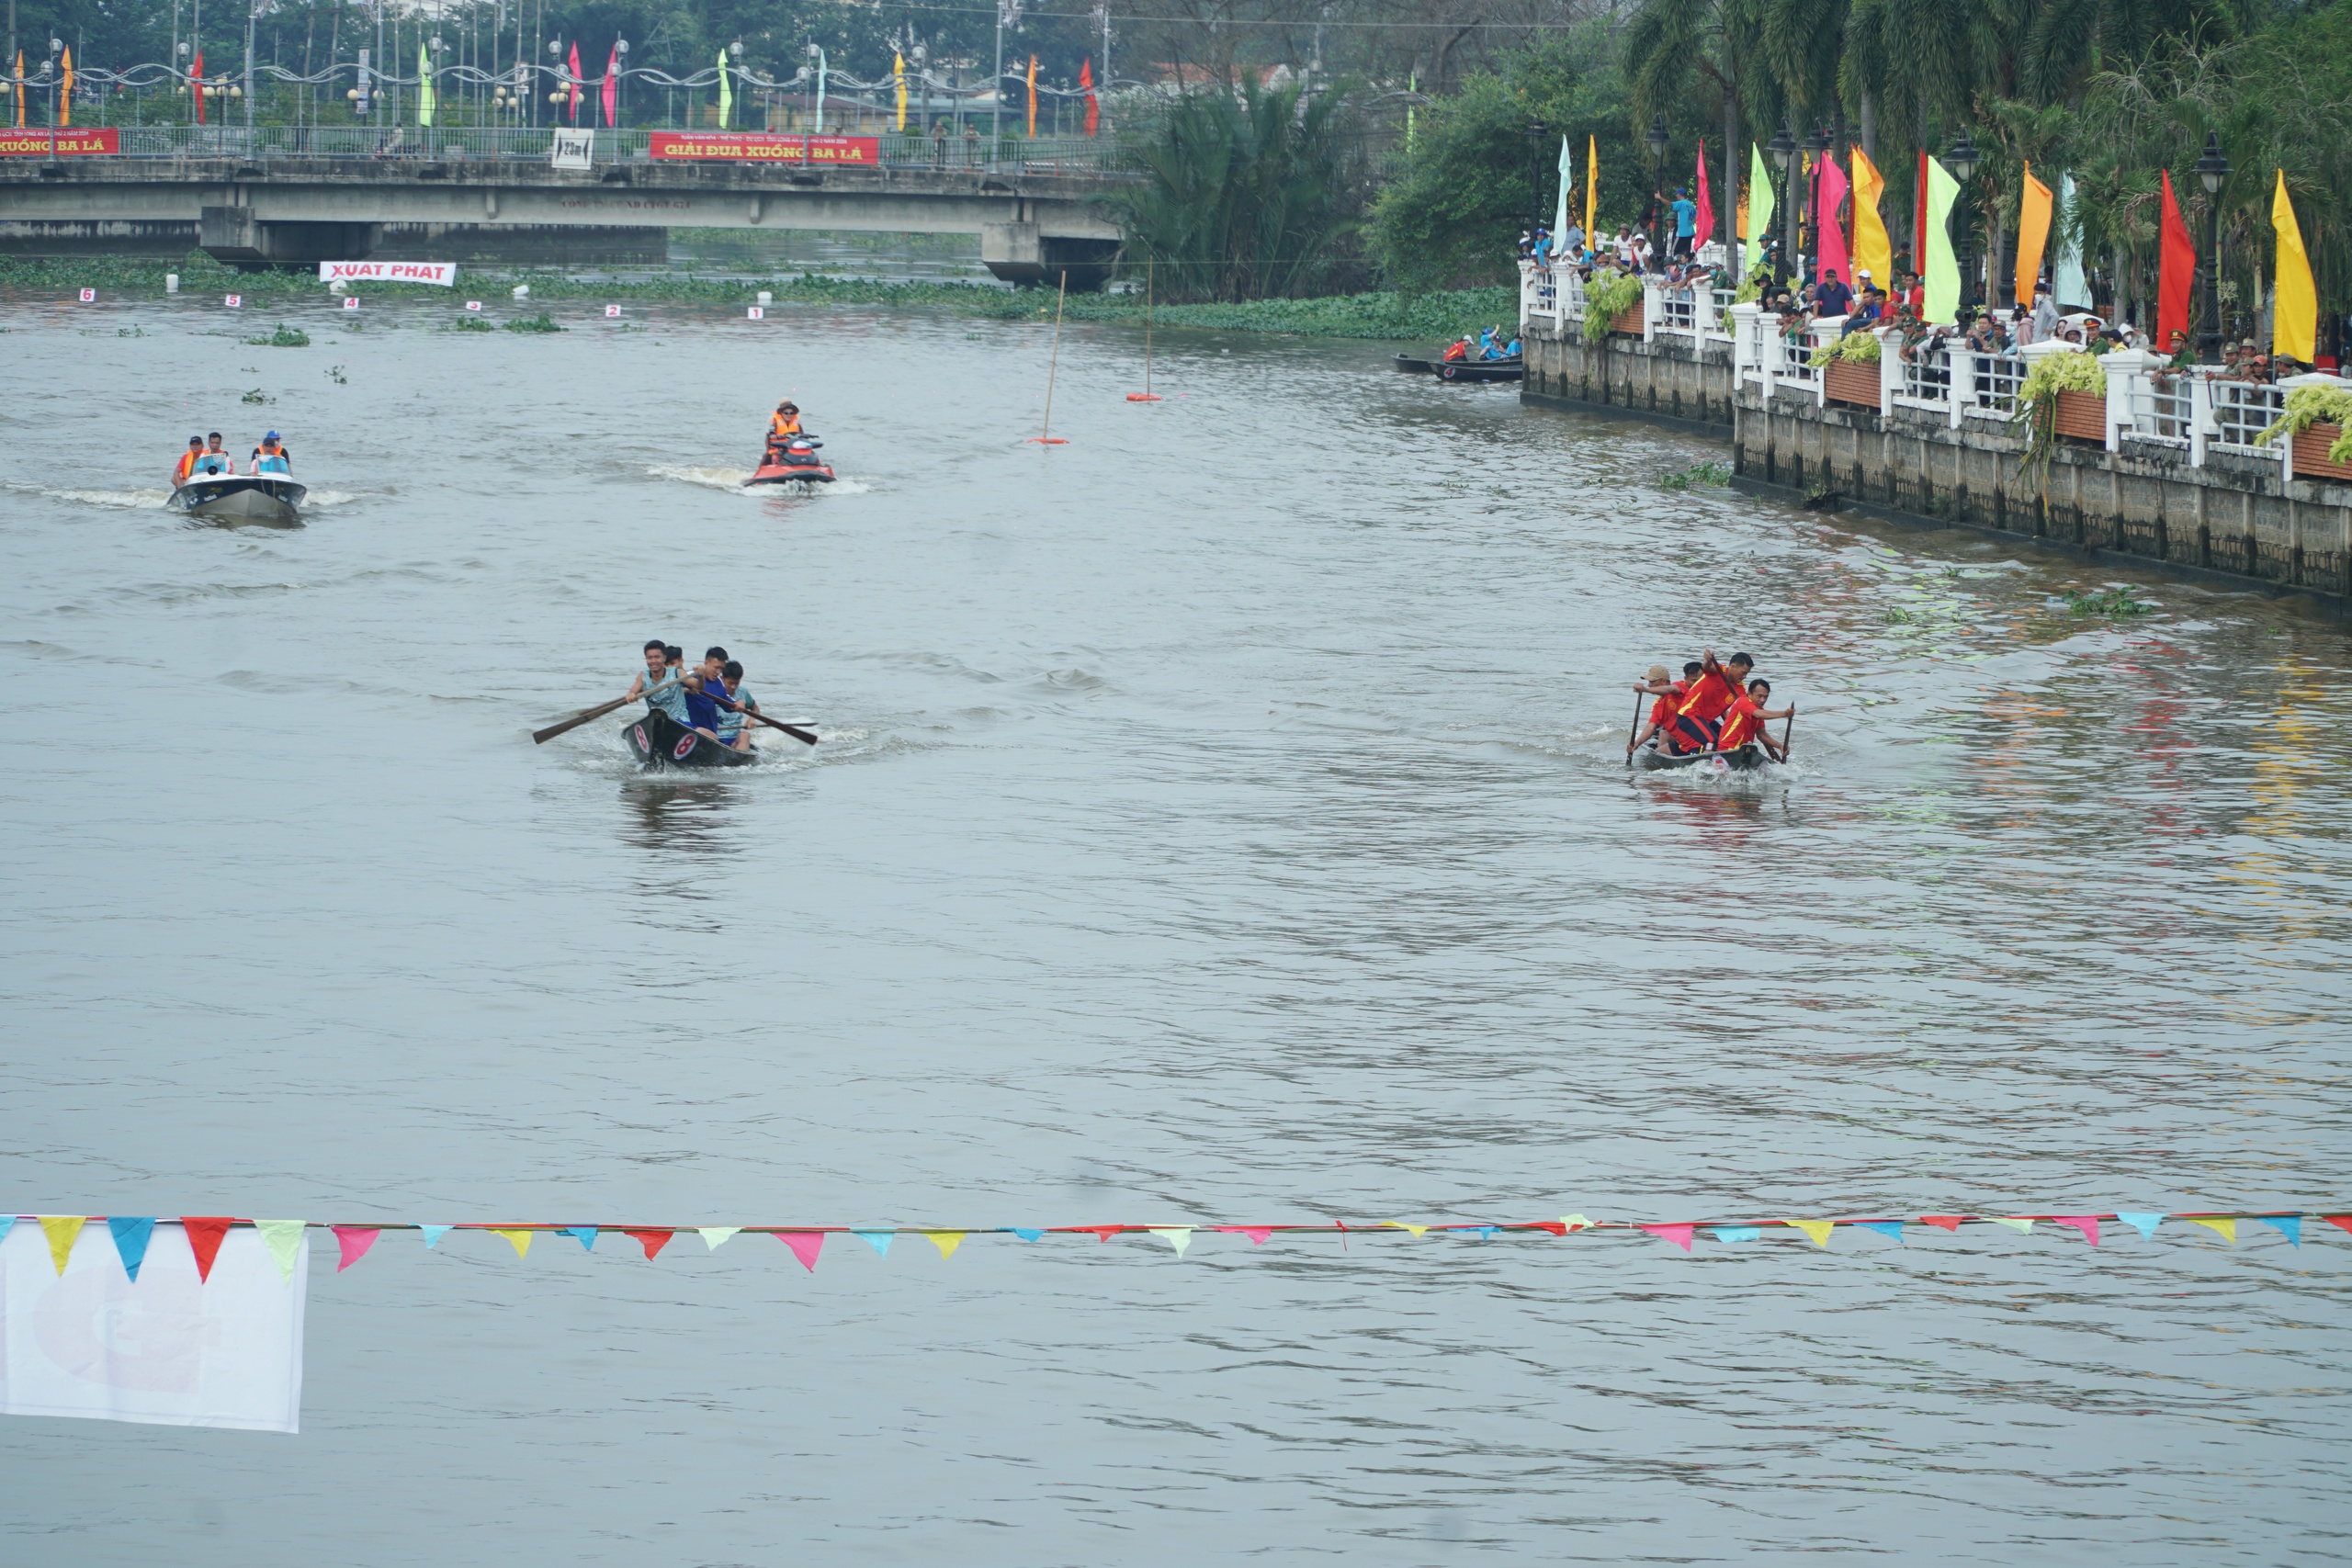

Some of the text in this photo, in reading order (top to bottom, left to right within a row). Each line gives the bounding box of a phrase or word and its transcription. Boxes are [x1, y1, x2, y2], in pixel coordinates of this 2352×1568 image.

[57, 141, 79, 151] BA
[83, 138, 105, 151] LÁ
[564, 141, 582, 156] 23m
[664, 141, 702, 155] GIẢI
[706, 145, 742, 157] ĐUA
[812, 148, 835, 159] BA
[840, 147, 863, 160] LÁ
[83, 288, 92, 300] 6
[229, 295, 238, 305] 5
[346, 298, 356, 308] 4
[608, 306, 617, 315] 2
[753, 309, 759, 318] 1
[676, 735, 695, 756] 8
